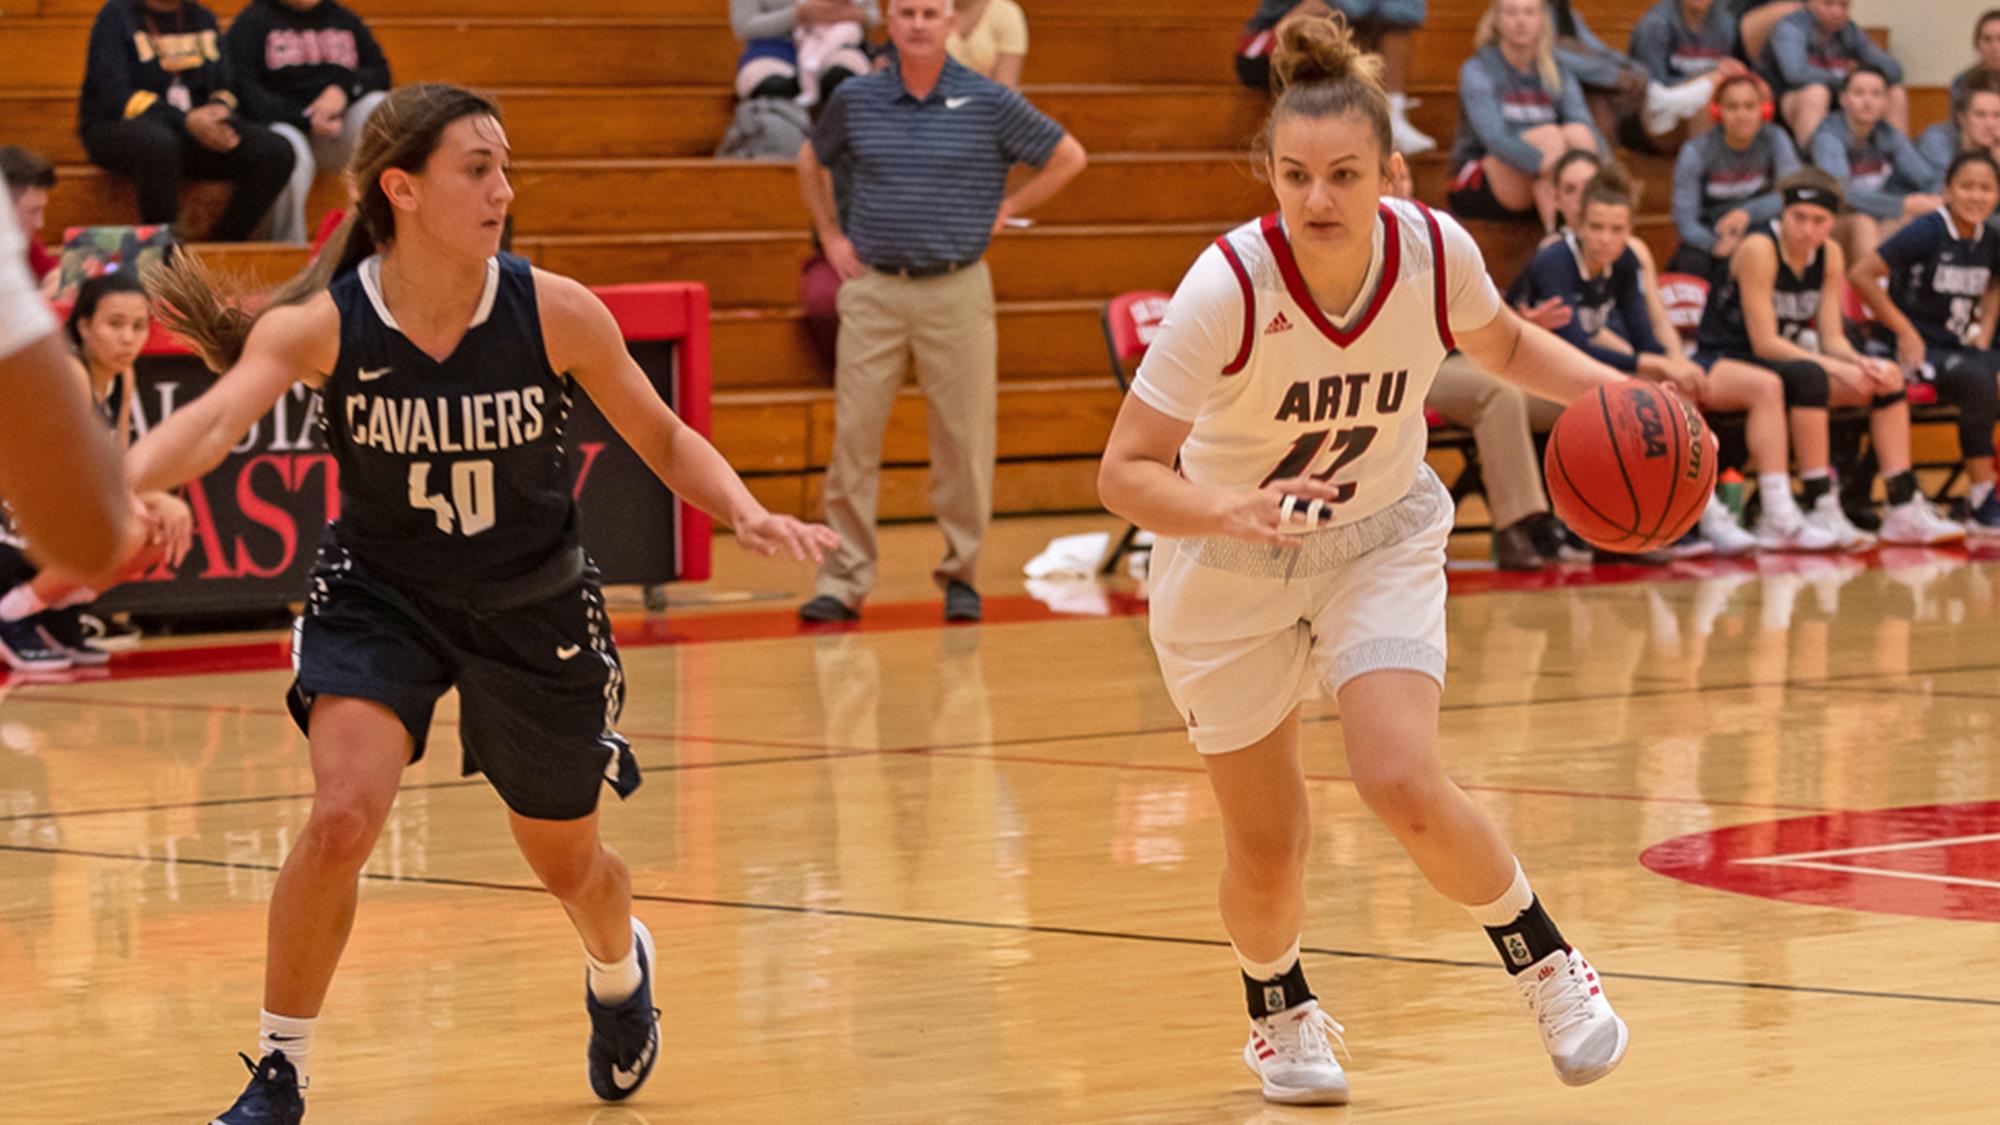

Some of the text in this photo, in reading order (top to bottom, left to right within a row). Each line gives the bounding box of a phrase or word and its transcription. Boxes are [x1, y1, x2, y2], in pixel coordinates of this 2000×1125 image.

[346, 385, 545, 454] CAVALIERS
[1274, 369, 1408, 423] ART U
[1626, 388, 1668, 459] NCAA
[407, 459, 496, 537] 40
[1257, 425, 1379, 504] 12
[124, 453, 341, 581] AST
